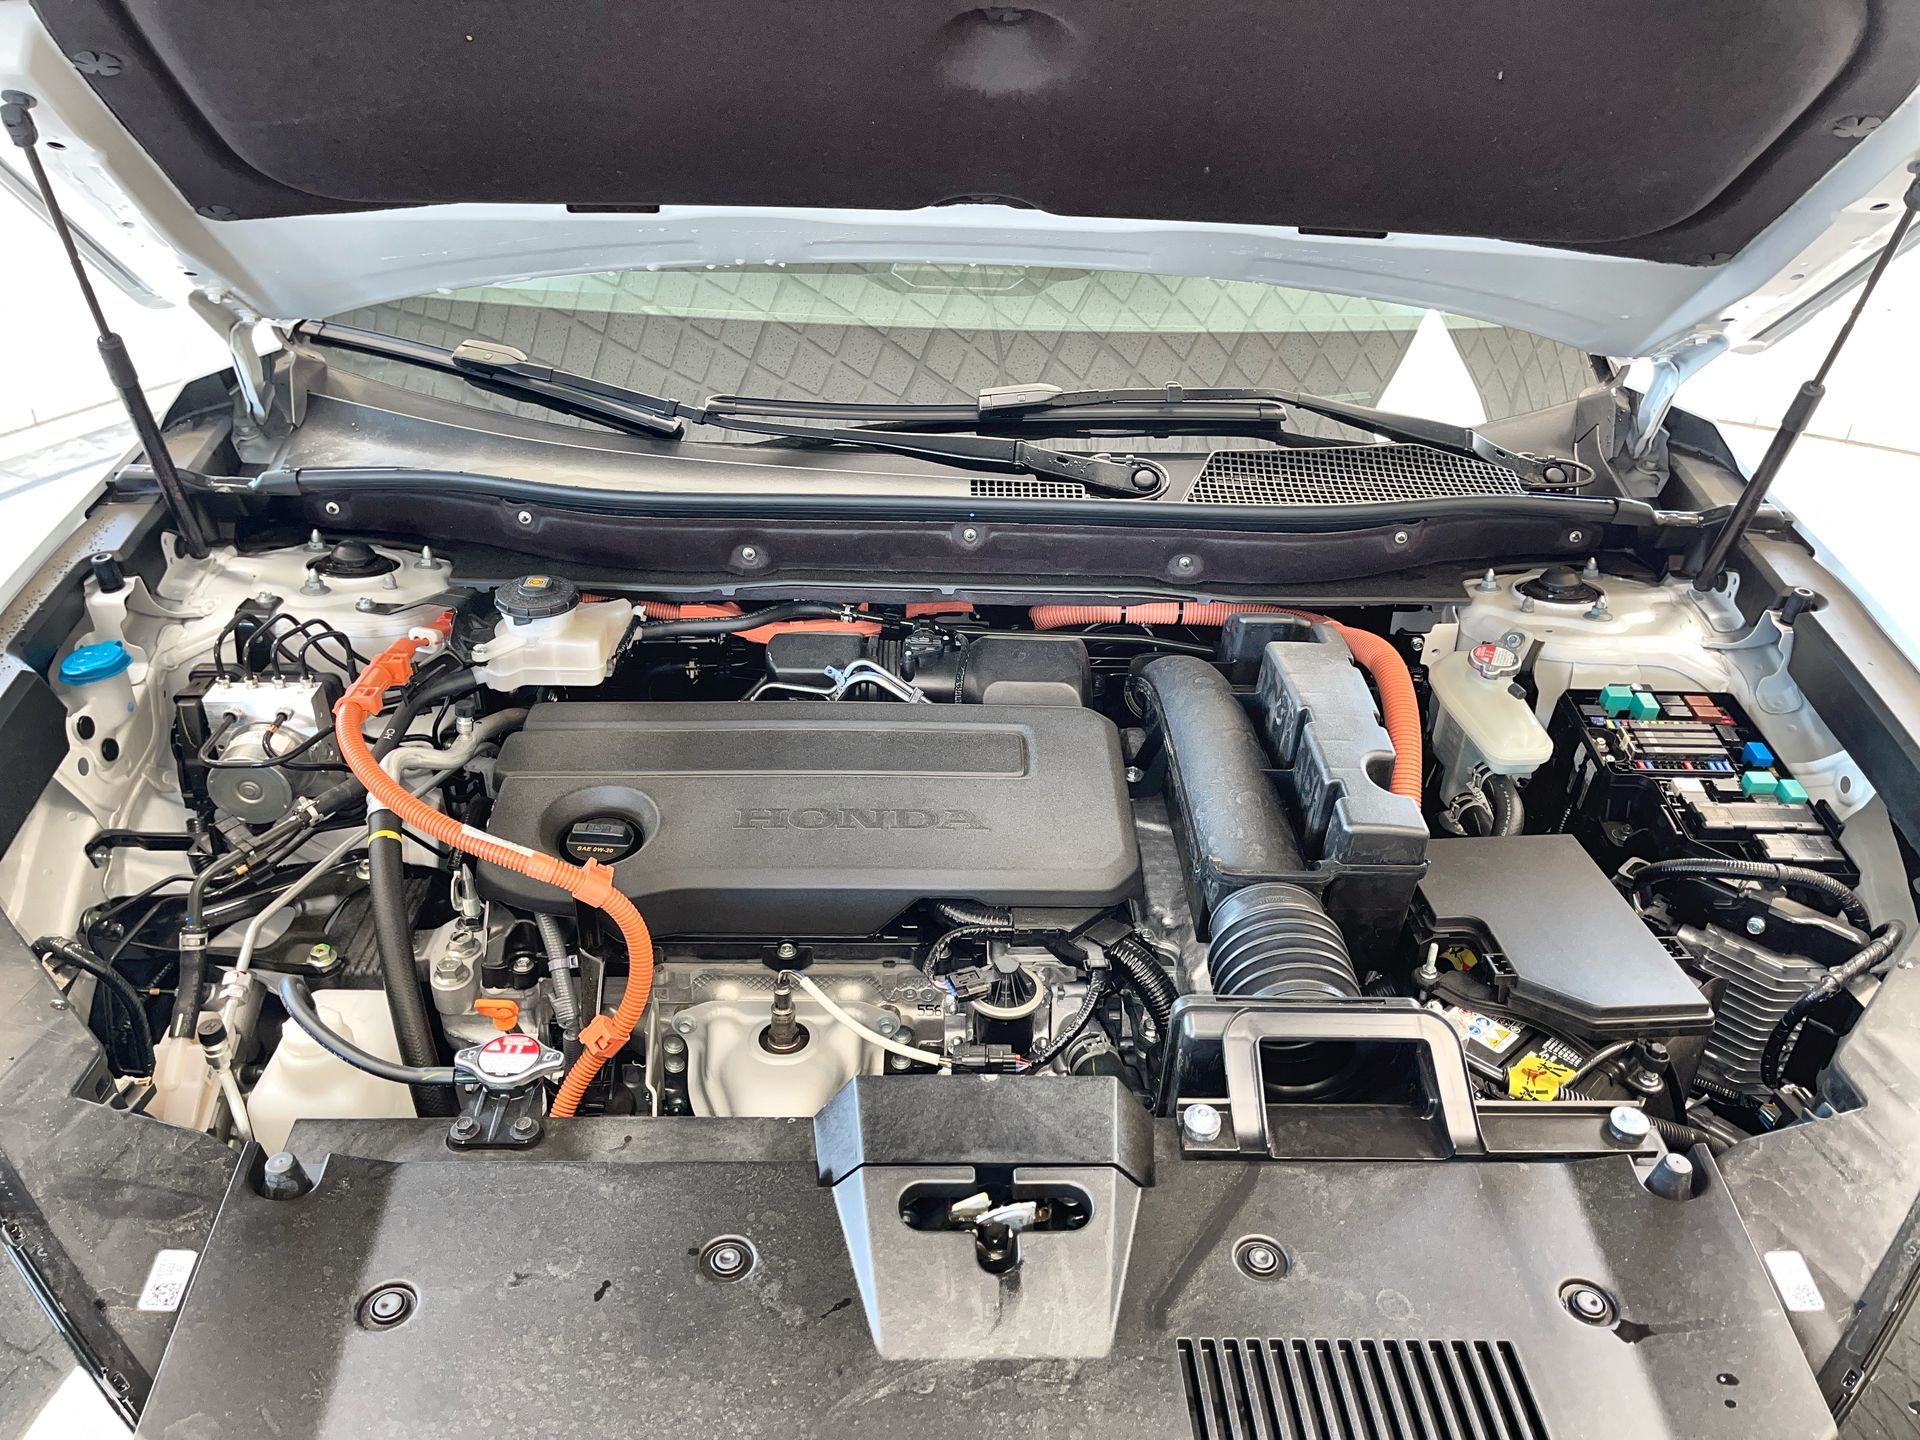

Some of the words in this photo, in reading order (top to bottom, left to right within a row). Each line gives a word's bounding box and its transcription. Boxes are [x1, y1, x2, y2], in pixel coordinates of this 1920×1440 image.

[732, 807, 992, 831] HONDA
[592, 846, 614, 854] 0W-20
[917, 1004, 942, 1017] 556
